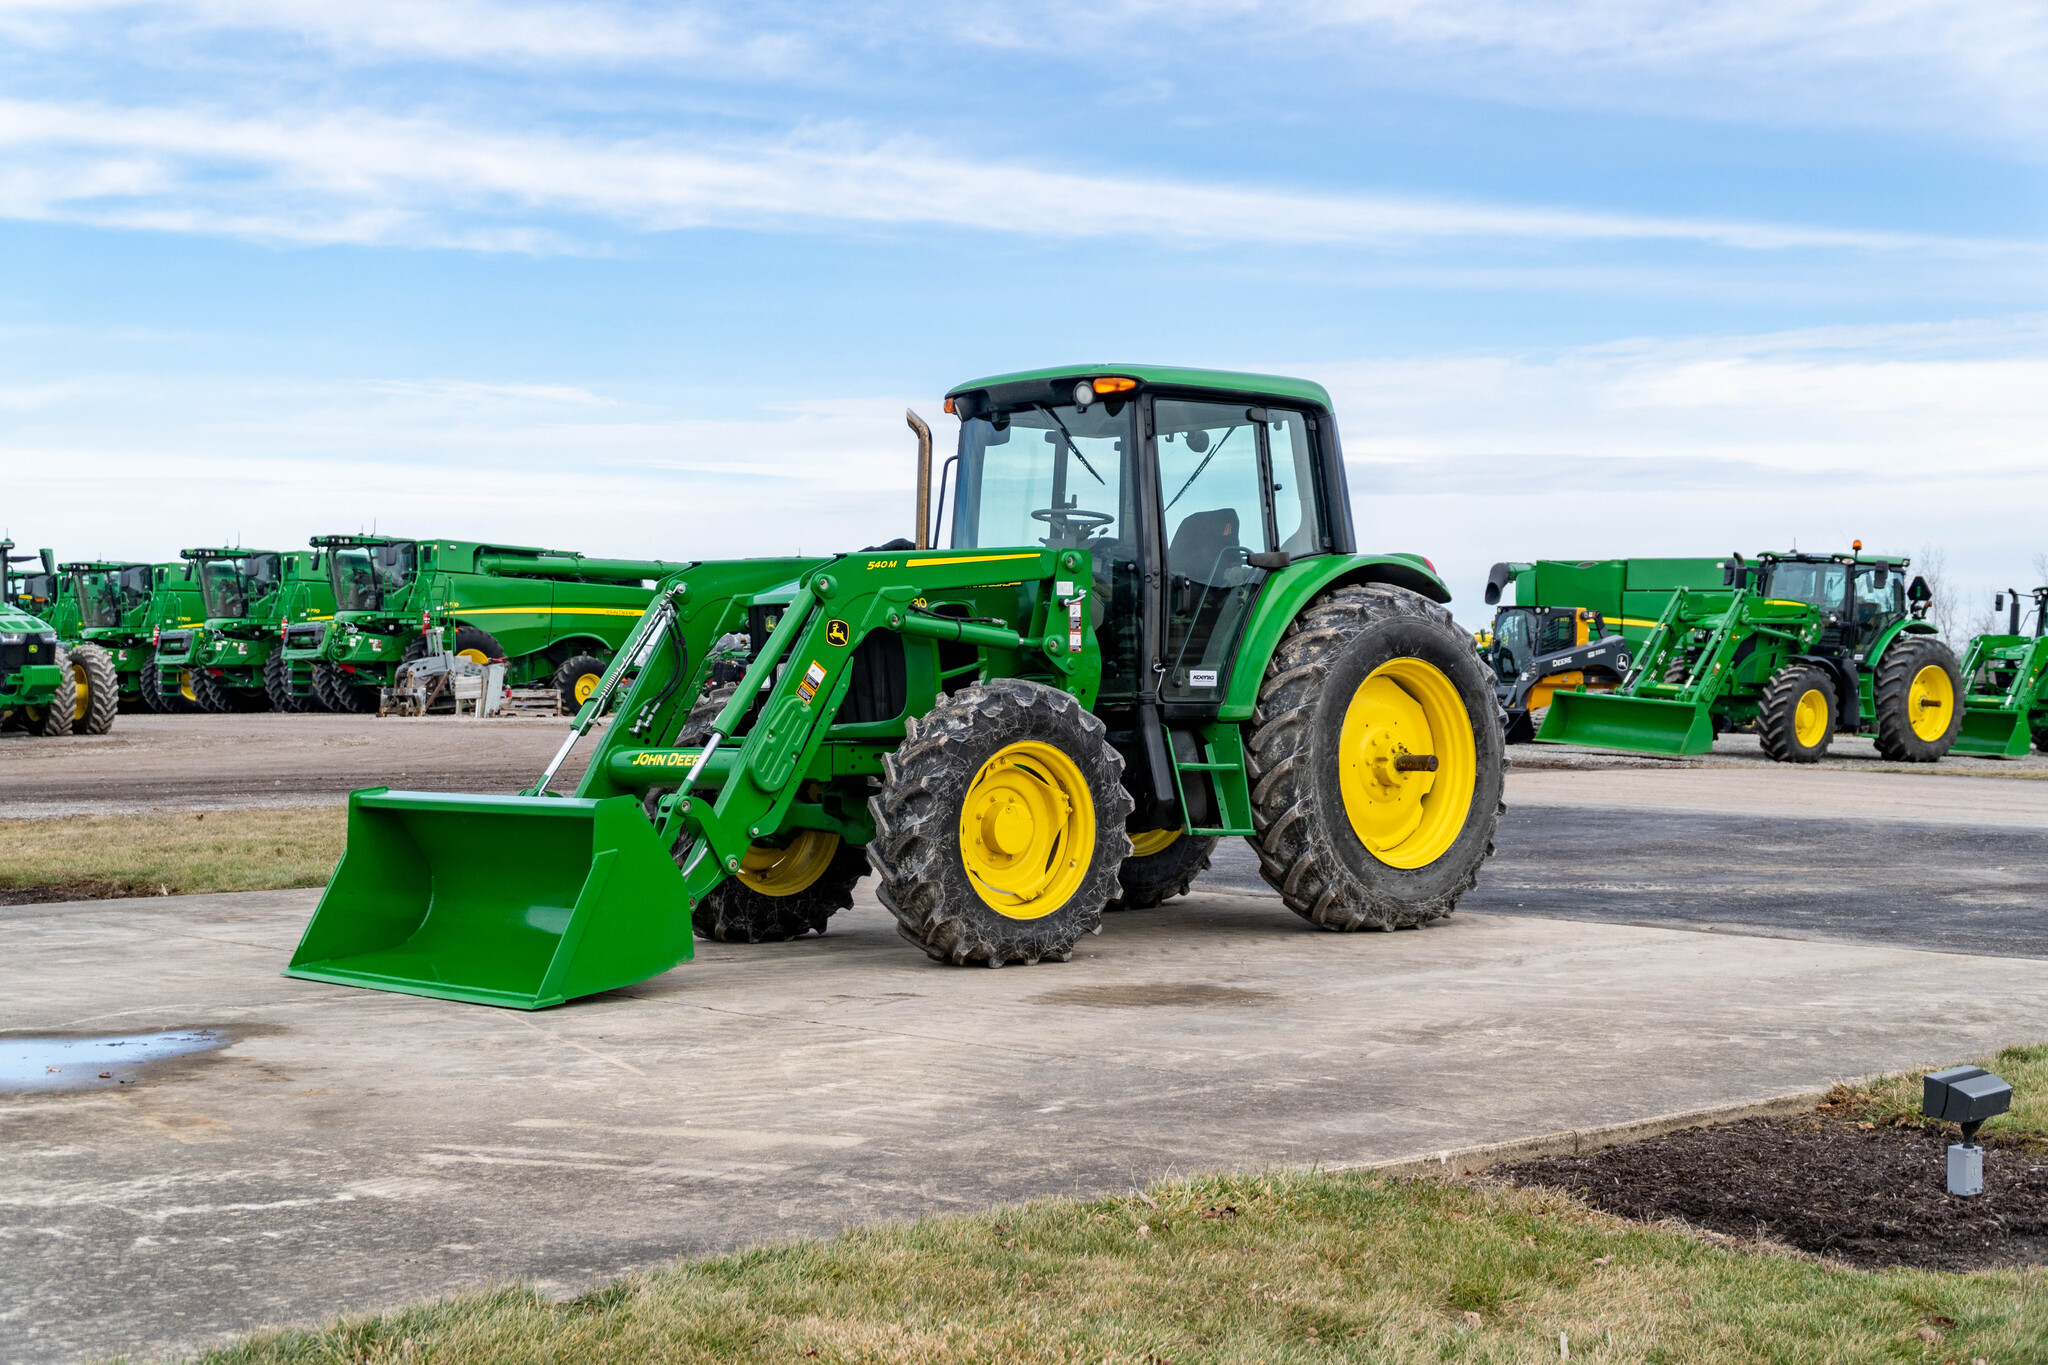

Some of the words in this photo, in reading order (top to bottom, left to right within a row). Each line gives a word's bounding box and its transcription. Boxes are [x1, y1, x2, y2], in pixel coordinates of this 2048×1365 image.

[867, 560, 888, 570] 540
[888, 560, 897, 568] M
[1552, 656, 1573, 668] DEERE
[632, 751, 667, 766] JOHN
